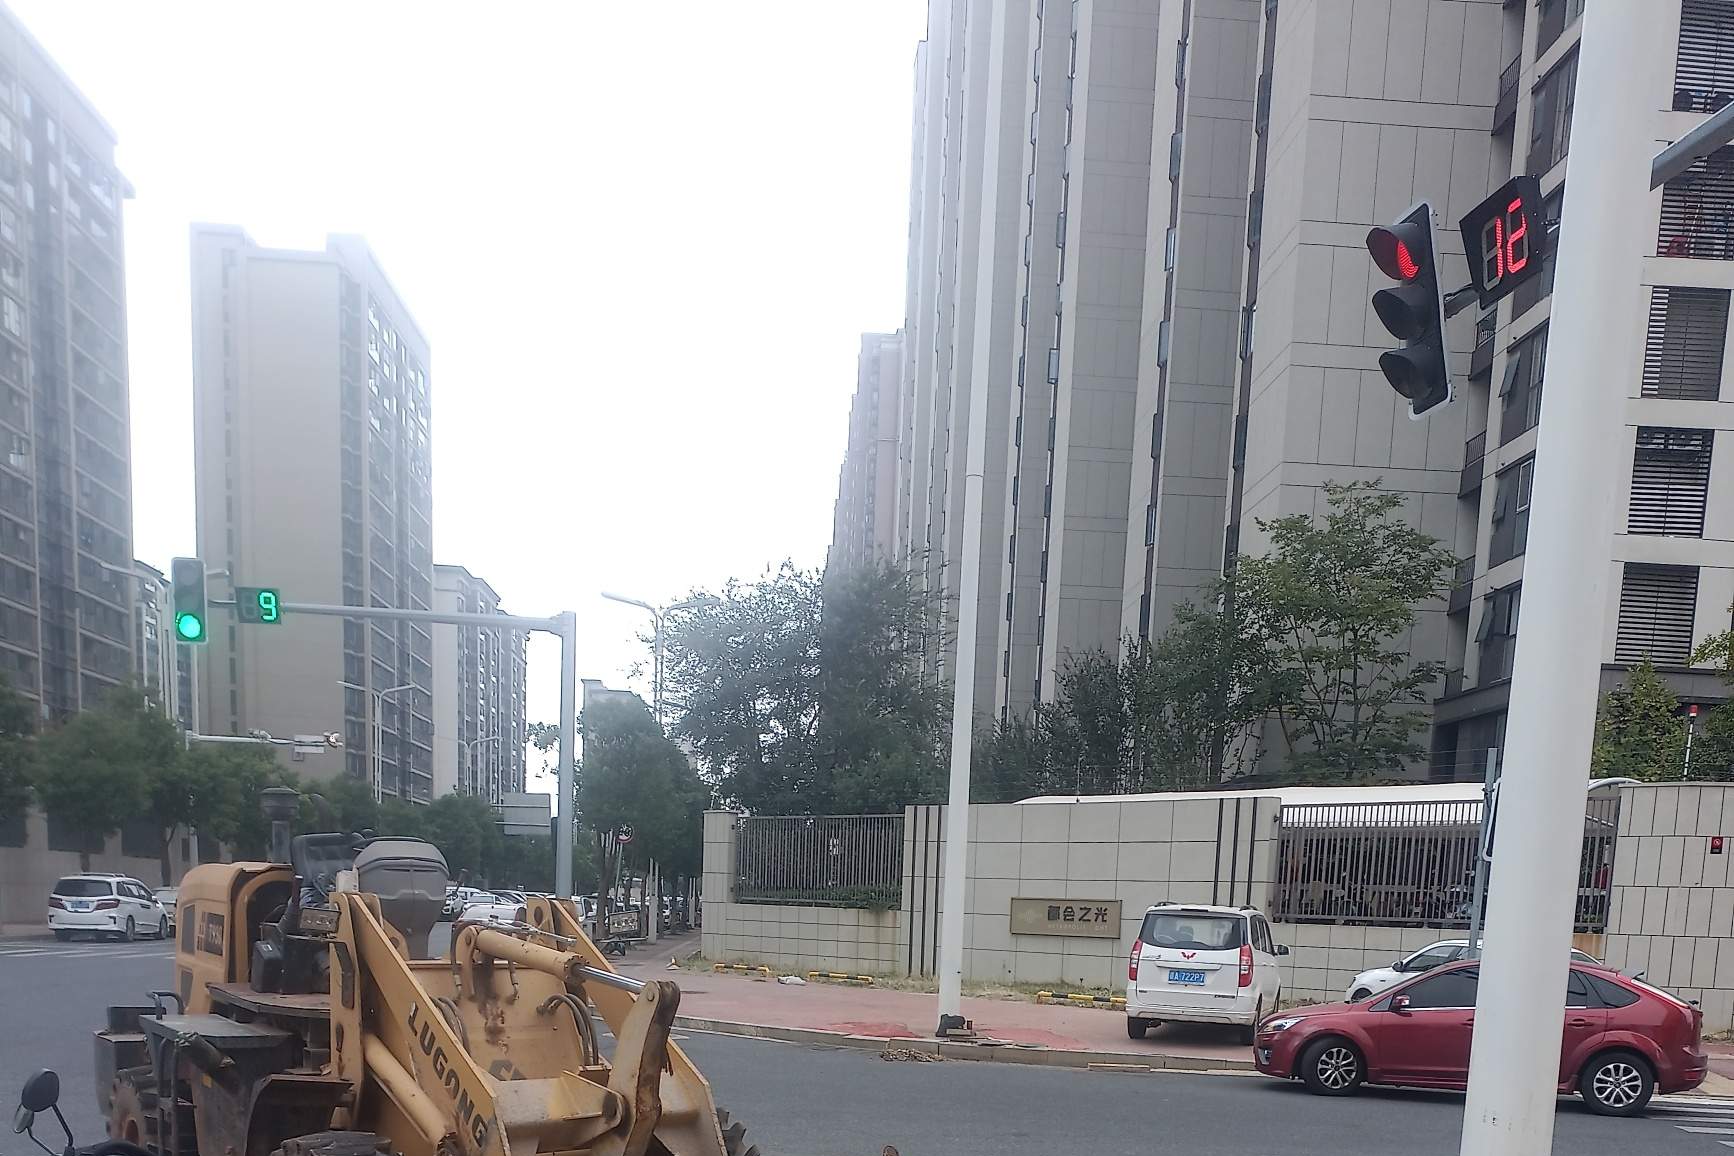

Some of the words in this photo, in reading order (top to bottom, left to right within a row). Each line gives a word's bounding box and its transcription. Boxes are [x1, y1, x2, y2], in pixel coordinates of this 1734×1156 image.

[1496, 198, 1527, 278] 12
[259, 592, 277, 621] 9
[1169, 971, 1205, 982] A722P7
[408, 1002, 488, 1148] LUGONG
